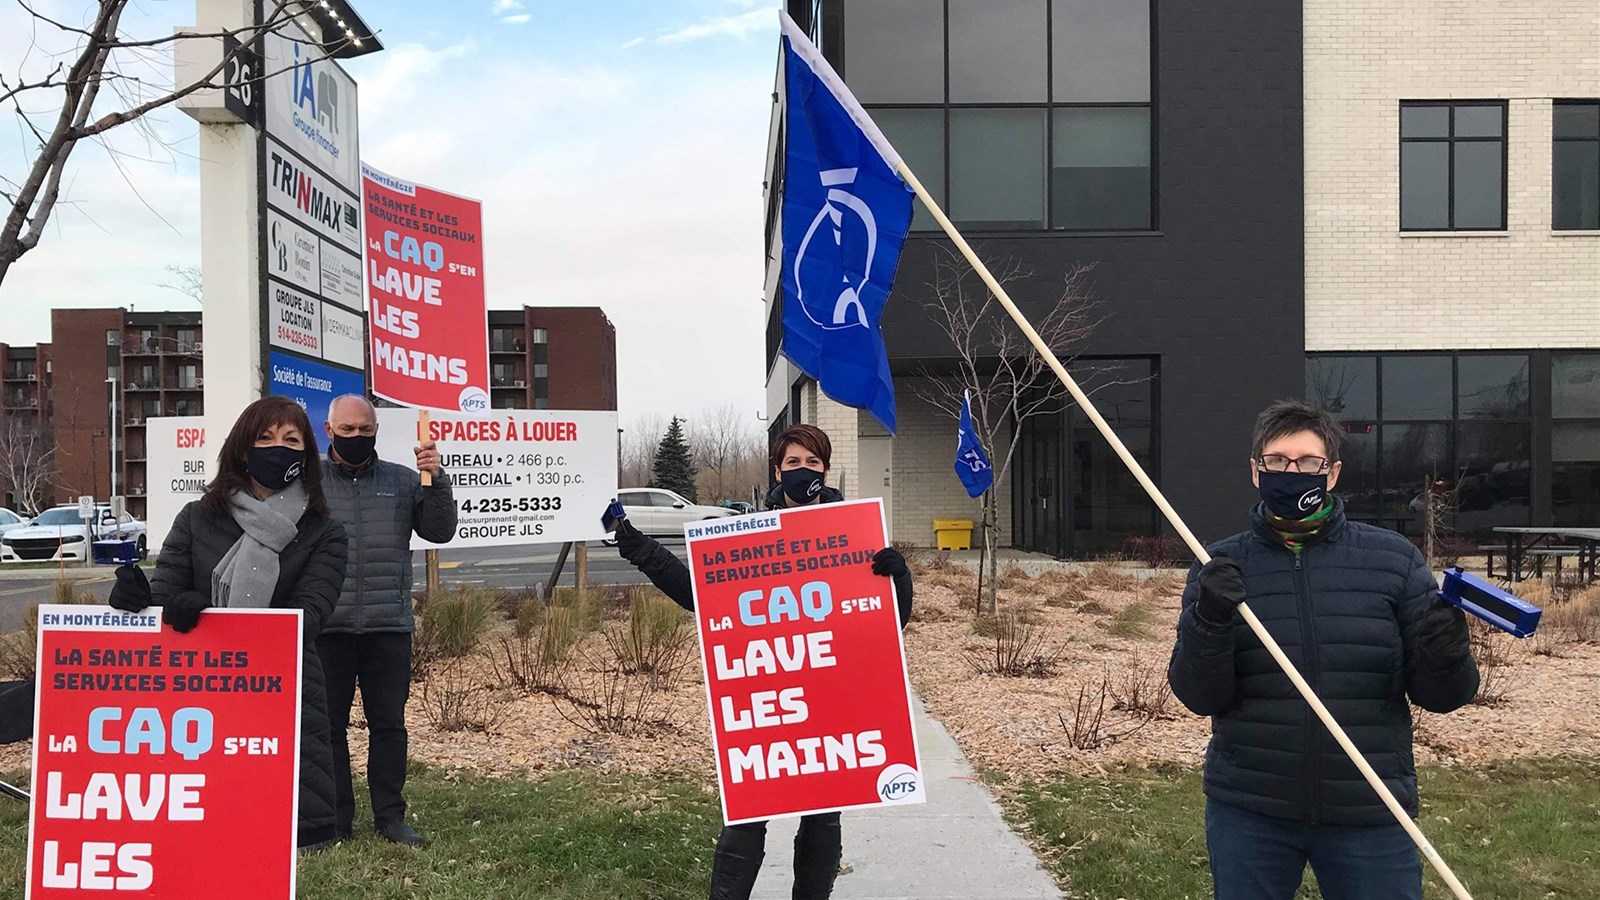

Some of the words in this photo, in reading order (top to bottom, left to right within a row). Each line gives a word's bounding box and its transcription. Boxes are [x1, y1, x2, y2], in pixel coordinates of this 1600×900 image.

[229, 55, 252, 107] 26
[293, 111, 316, 141] Groupe
[271, 151, 342, 233] TRINMAX
[362, 167, 370, 176] EN
[370, 170, 413, 193] MONTÉRÉGIE
[368, 189, 380, 202] LA
[382, 194, 417, 217] SANTÉ
[419, 208, 434, 220] ET
[437, 213, 458, 226] LES
[368, 203, 420, 230] SERVICES
[422, 222, 475, 243] SOCIAUX
[369, 237, 381, 252] LA
[384, 229, 444, 272] CAQ
[449, 262, 476, 277] S'EN
[371, 258, 442, 306] LAVE
[276, 289, 302, 310] GROUPE
[303, 300, 314, 315] JLS
[372, 297, 420, 339] LES
[281, 308, 312, 331] LOCATION
[278, 325, 317, 349] 514-235-5333
[375, 337, 468, 385] MAINS
[273, 364, 295, 385] Société
[296, 371, 303, 387] de
[304, 372, 332, 393] l'assurance
[461, 399, 486, 409] APTS
[506, 417, 518, 441] À
[523, 421, 577, 441] LOUER
[518, 455, 541, 466] 466
[546, 457, 567, 468] p.c.
[537, 473, 560, 484] 330
[563, 475, 584, 487] p.c.
[459, 526, 516, 539] GROUPE
[520, 524, 544, 536] JLS
[688, 528, 702, 538] EN
[705, 517, 777, 536] MONTÉRÉGIE
[703, 551, 726, 567] LA
[729, 540, 785, 563] SANTÉ
[790, 539, 811, 554] ET
[815, 534, 849, 550] LES
[704, 560, 793, 585] SERVICES
[796, 549, 876, 572] SOCIAUX
[43, 613, 60, 626] EN
[63, 612, 157, 628] MONTÉRÉGIE
[709, 616, 733, 631] LA
[738, 580, 833, 627] CAQ
[840, 596, 882, 614] S'EN
[54, 648, 82, 666] LA
[88, 645, 162, 667] SANTÉ
[169, 651, 198, 668] ET
[204, 651, 248, 668] LES
[713, 630, 837, 681] LAVE
[53, 673, 166, 692] SERVICES
[173, 675, 282, 693] SOCIAUX
[720, 686, 809, 733] LES
[49, 734, 77, 753] LA
[88, 706, 214, 761] CAQ
[224, 737, 278, 755] S'EN
[726, 729, 887, 784] MAINS
[46, 771, 206, 821] LAVE
[881, 780, 916, 795] APTS
[42, 840, 153, 890] LES
